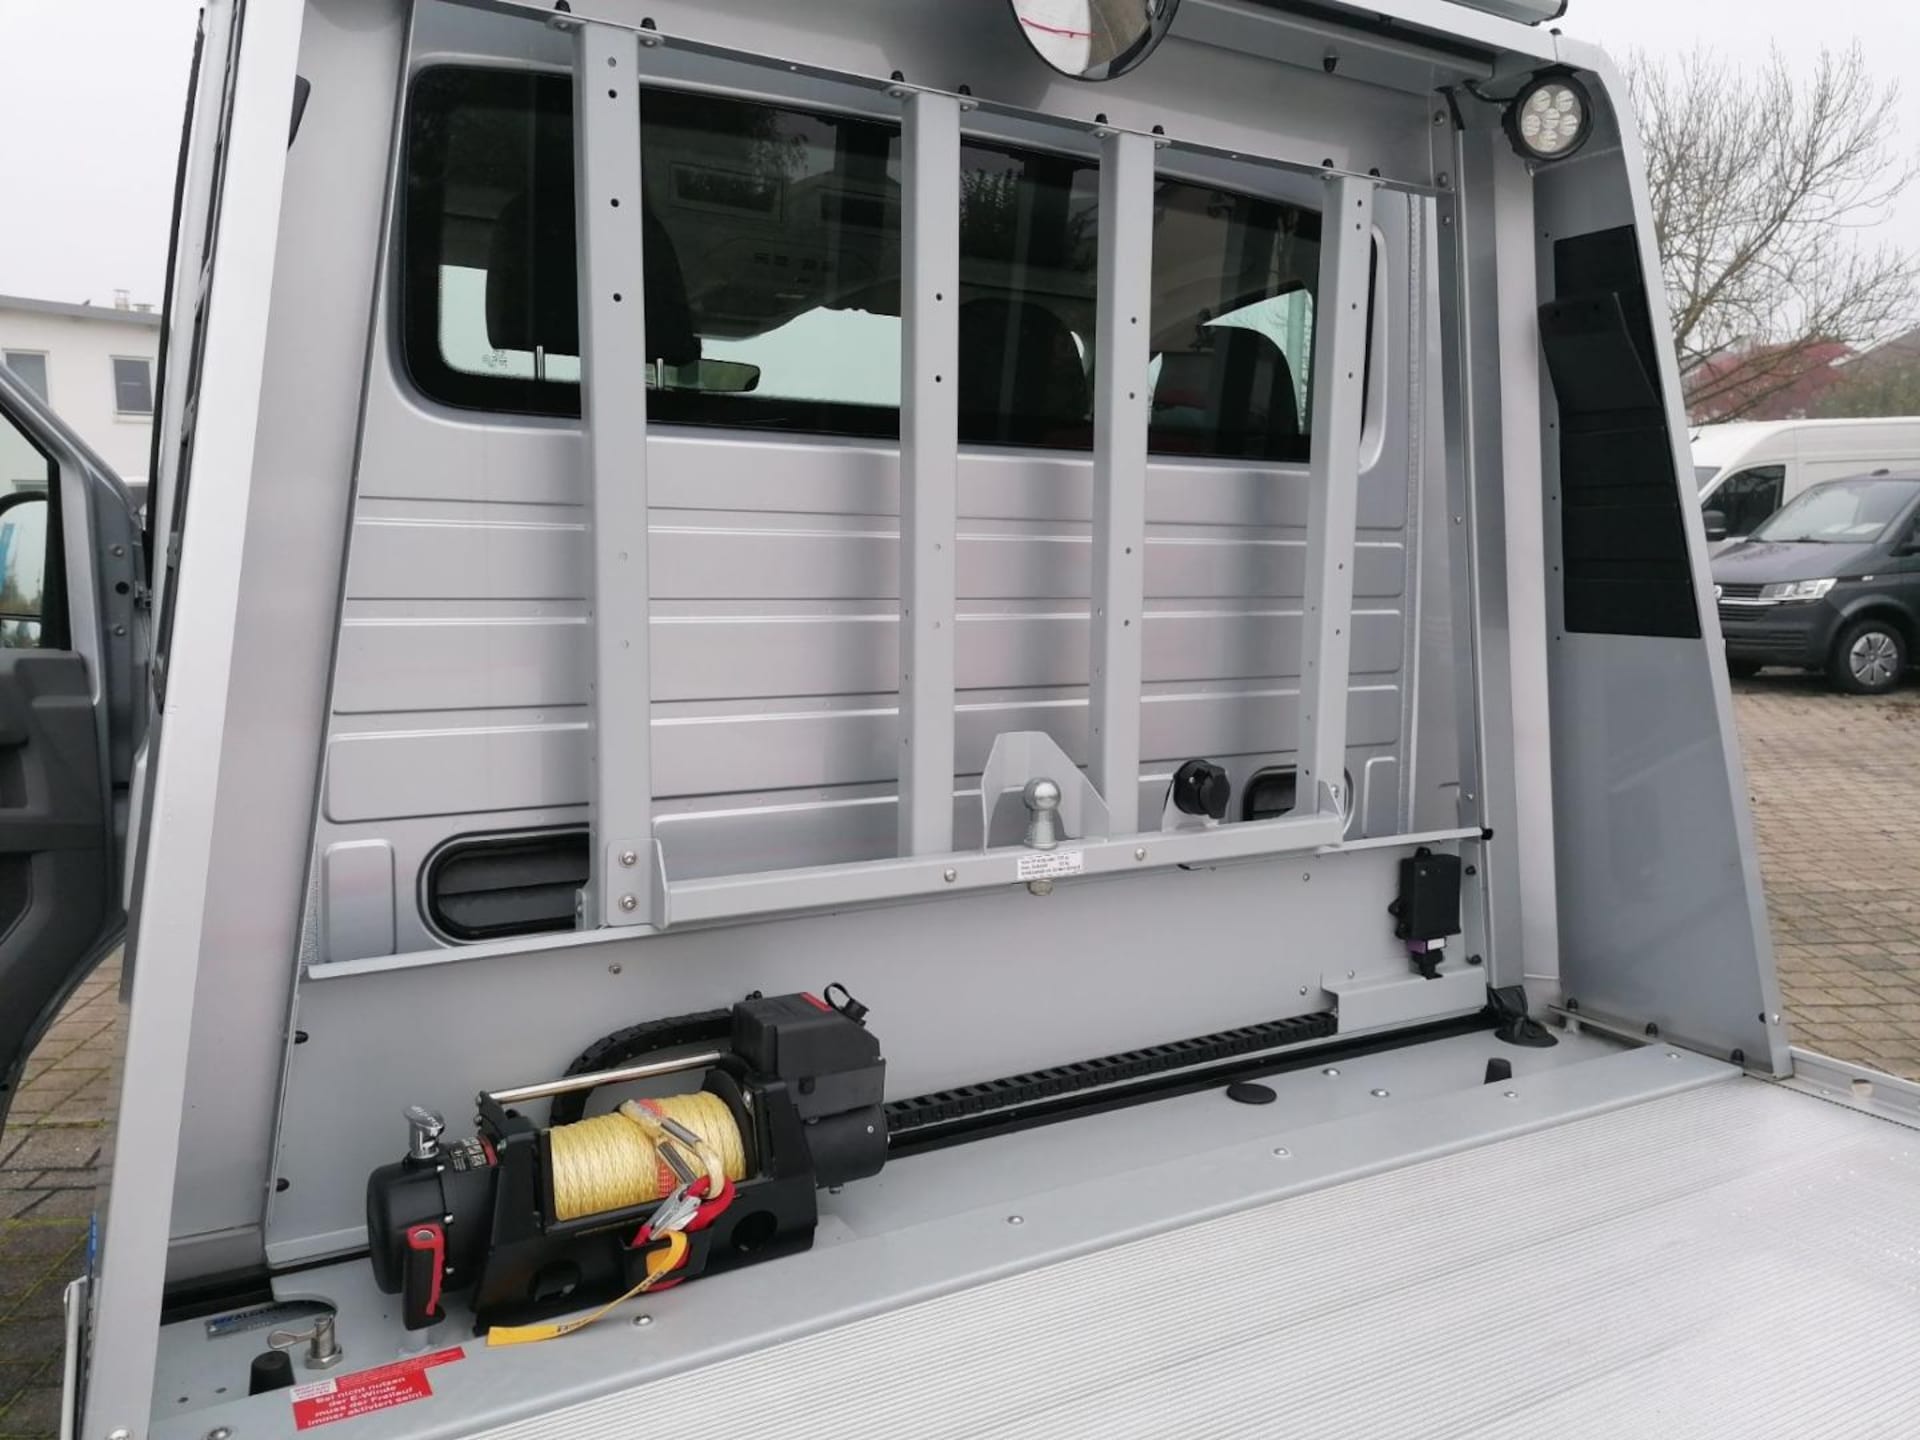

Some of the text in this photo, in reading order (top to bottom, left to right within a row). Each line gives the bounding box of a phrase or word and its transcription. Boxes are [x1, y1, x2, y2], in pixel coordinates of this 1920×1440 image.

[328, 1386, 397, 1409] der E-Winde
[337, 1386, 365, 1398] nicht
[368, 1377, 405, 1390] nutzen
[314, 1404, 347, 1418] muss
[370, 1386, 413, 1403] Freilauf
[347, 1399, 392, 1415] aktiviert
